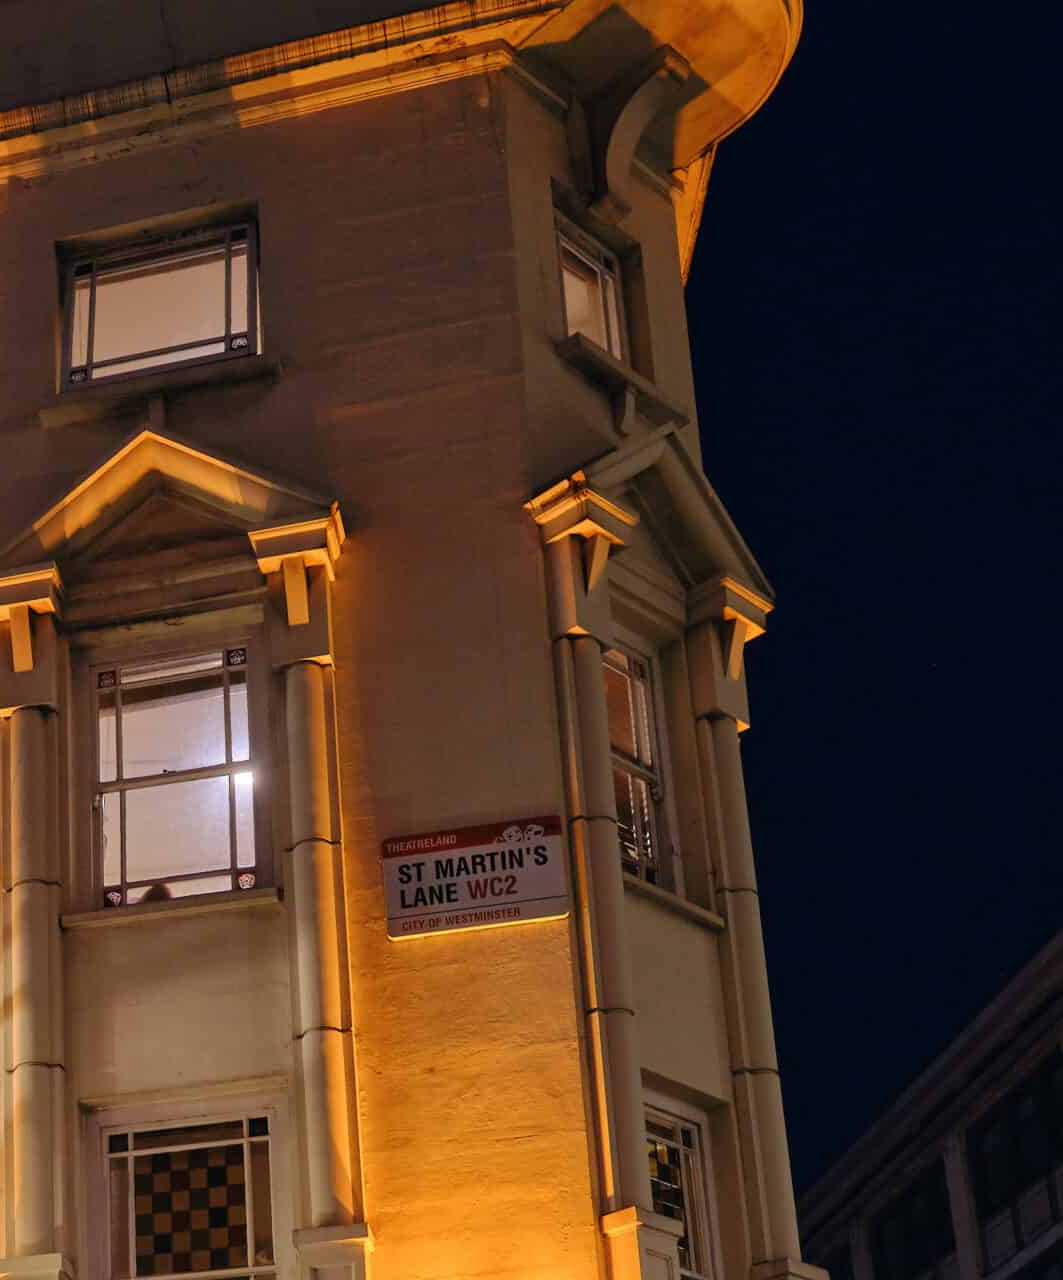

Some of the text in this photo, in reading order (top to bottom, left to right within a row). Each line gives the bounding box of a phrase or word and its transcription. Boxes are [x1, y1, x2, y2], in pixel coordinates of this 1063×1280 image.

[387, 834, 457, 853] THEATRELAND
[398, 845, 549, 884] ST MARTIN'S
[400, 875, 518, 909] LANE WC2
[402, 907, 521, 932] CITY OF WESTMINSTER
